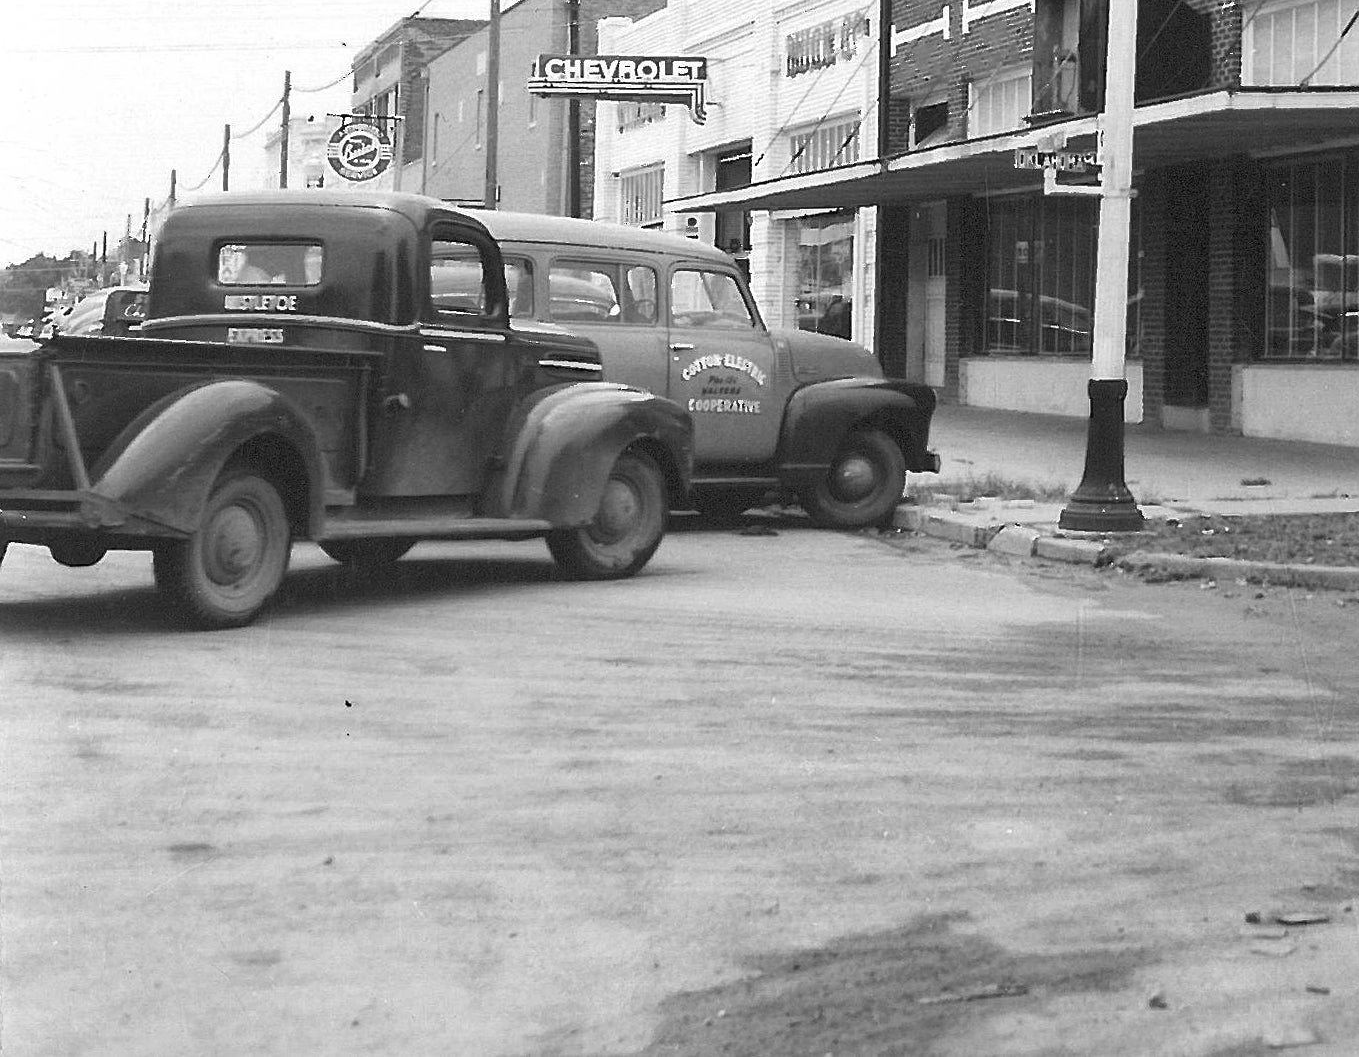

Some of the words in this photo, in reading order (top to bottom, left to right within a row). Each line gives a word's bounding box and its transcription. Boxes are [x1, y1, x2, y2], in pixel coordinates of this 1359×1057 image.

[544, 58, 704, 81] CHEVROLET
[682, 354, 723, 381] COTTON
[723, 353, 767, 386] ELECTRIC
[687, 398, 762, 414] COOPERATIVE
